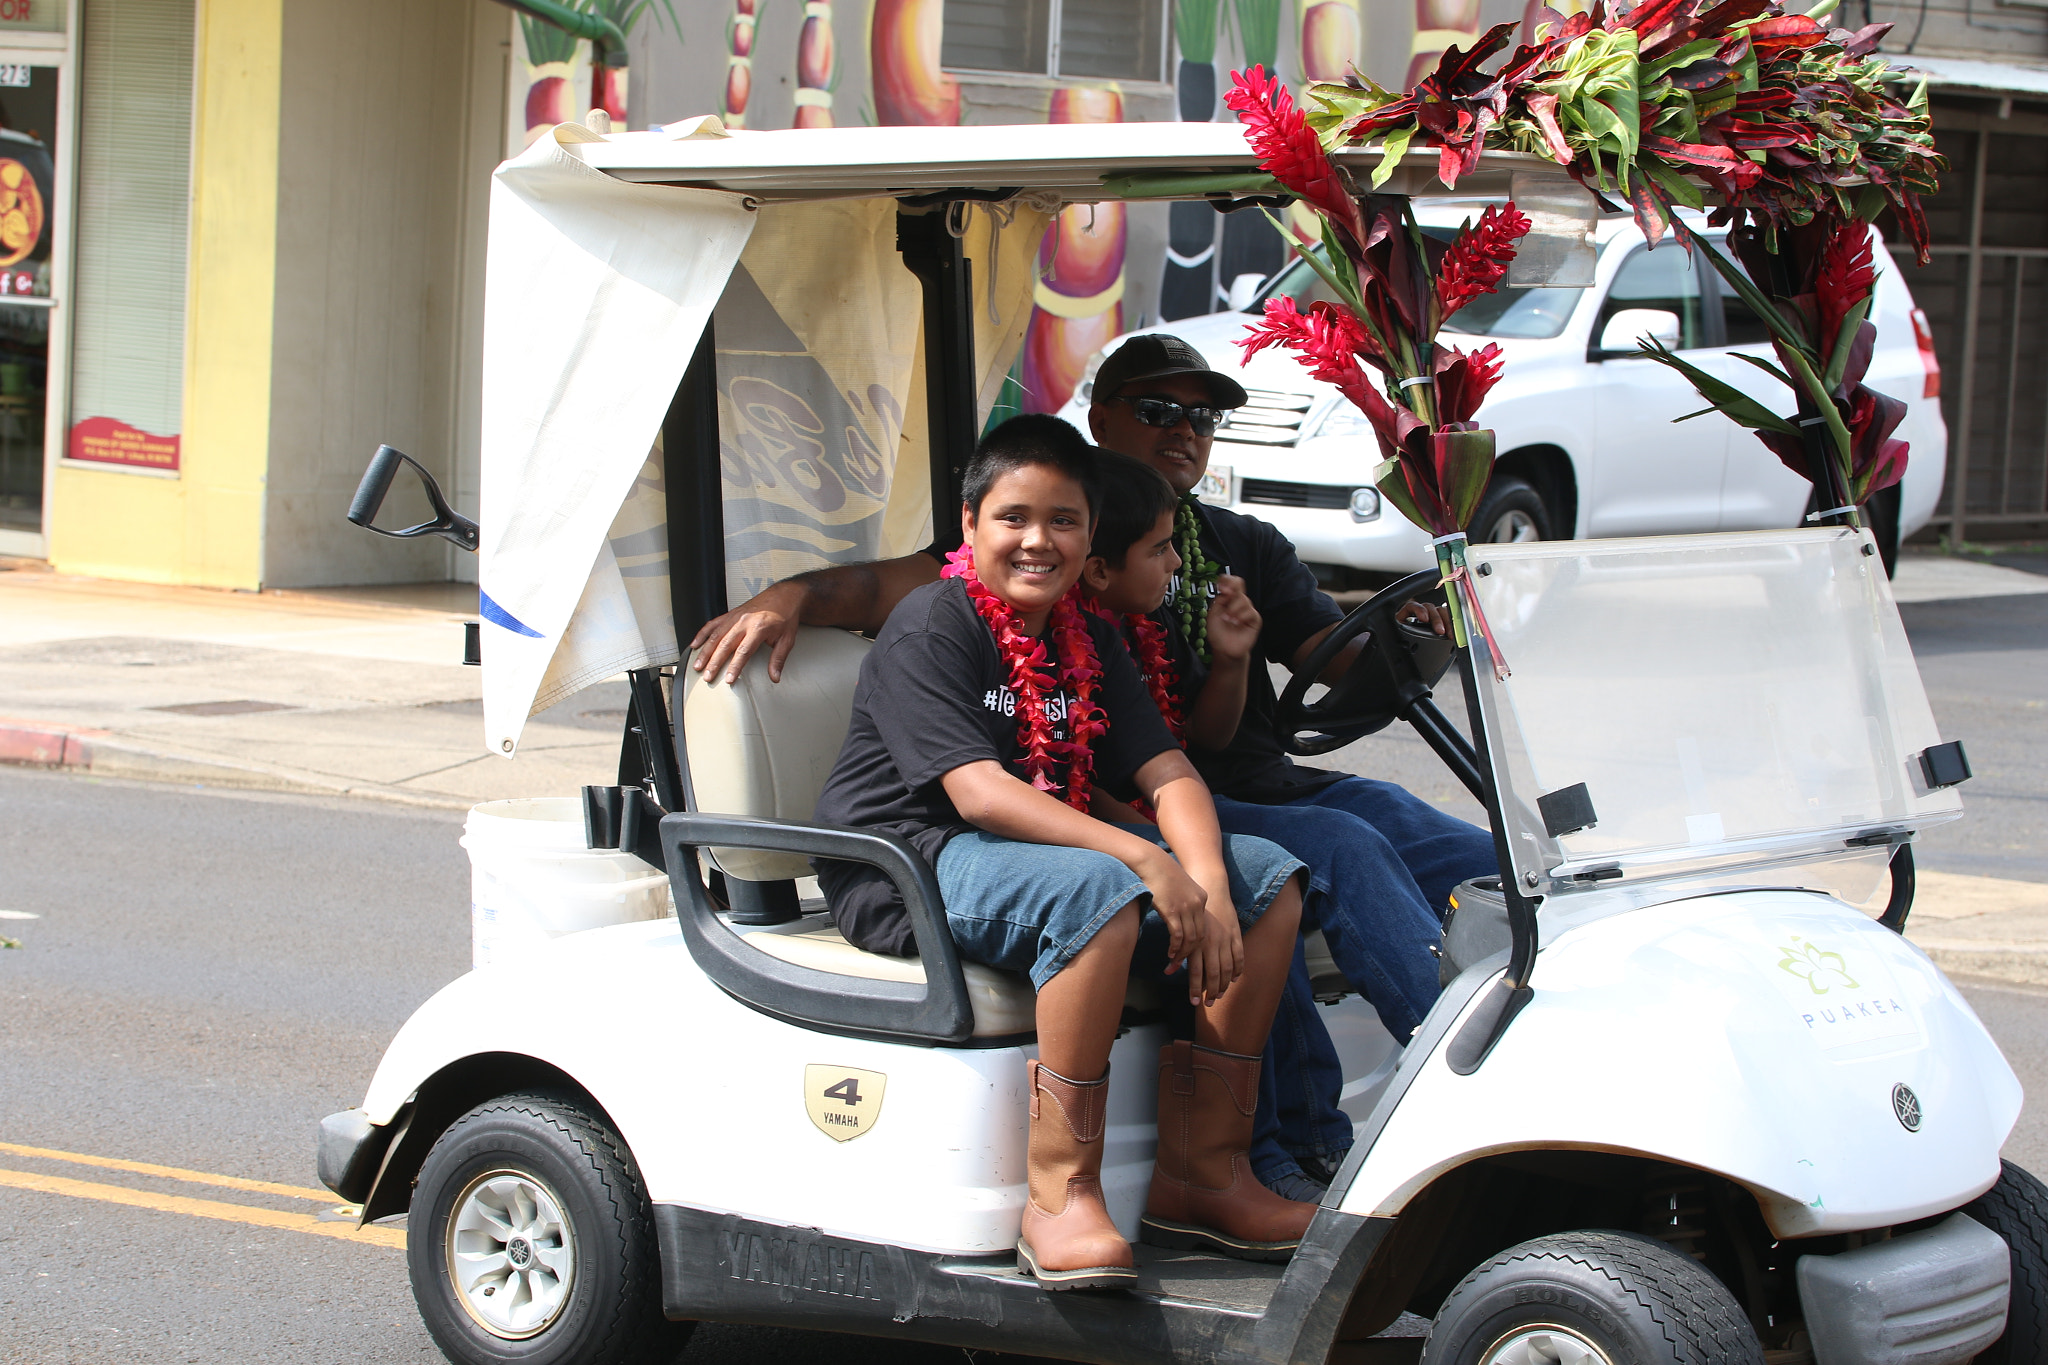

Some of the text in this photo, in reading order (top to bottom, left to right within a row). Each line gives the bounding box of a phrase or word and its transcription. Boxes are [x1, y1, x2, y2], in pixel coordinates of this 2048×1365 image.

[1801, 998, 1903, 1029] PUAKEA
[823, 1077, 863, 1106] 4
[823, 1111, 859, 1128] YAMAHA
[723, 1229, 881, 1301] YAMAHA
